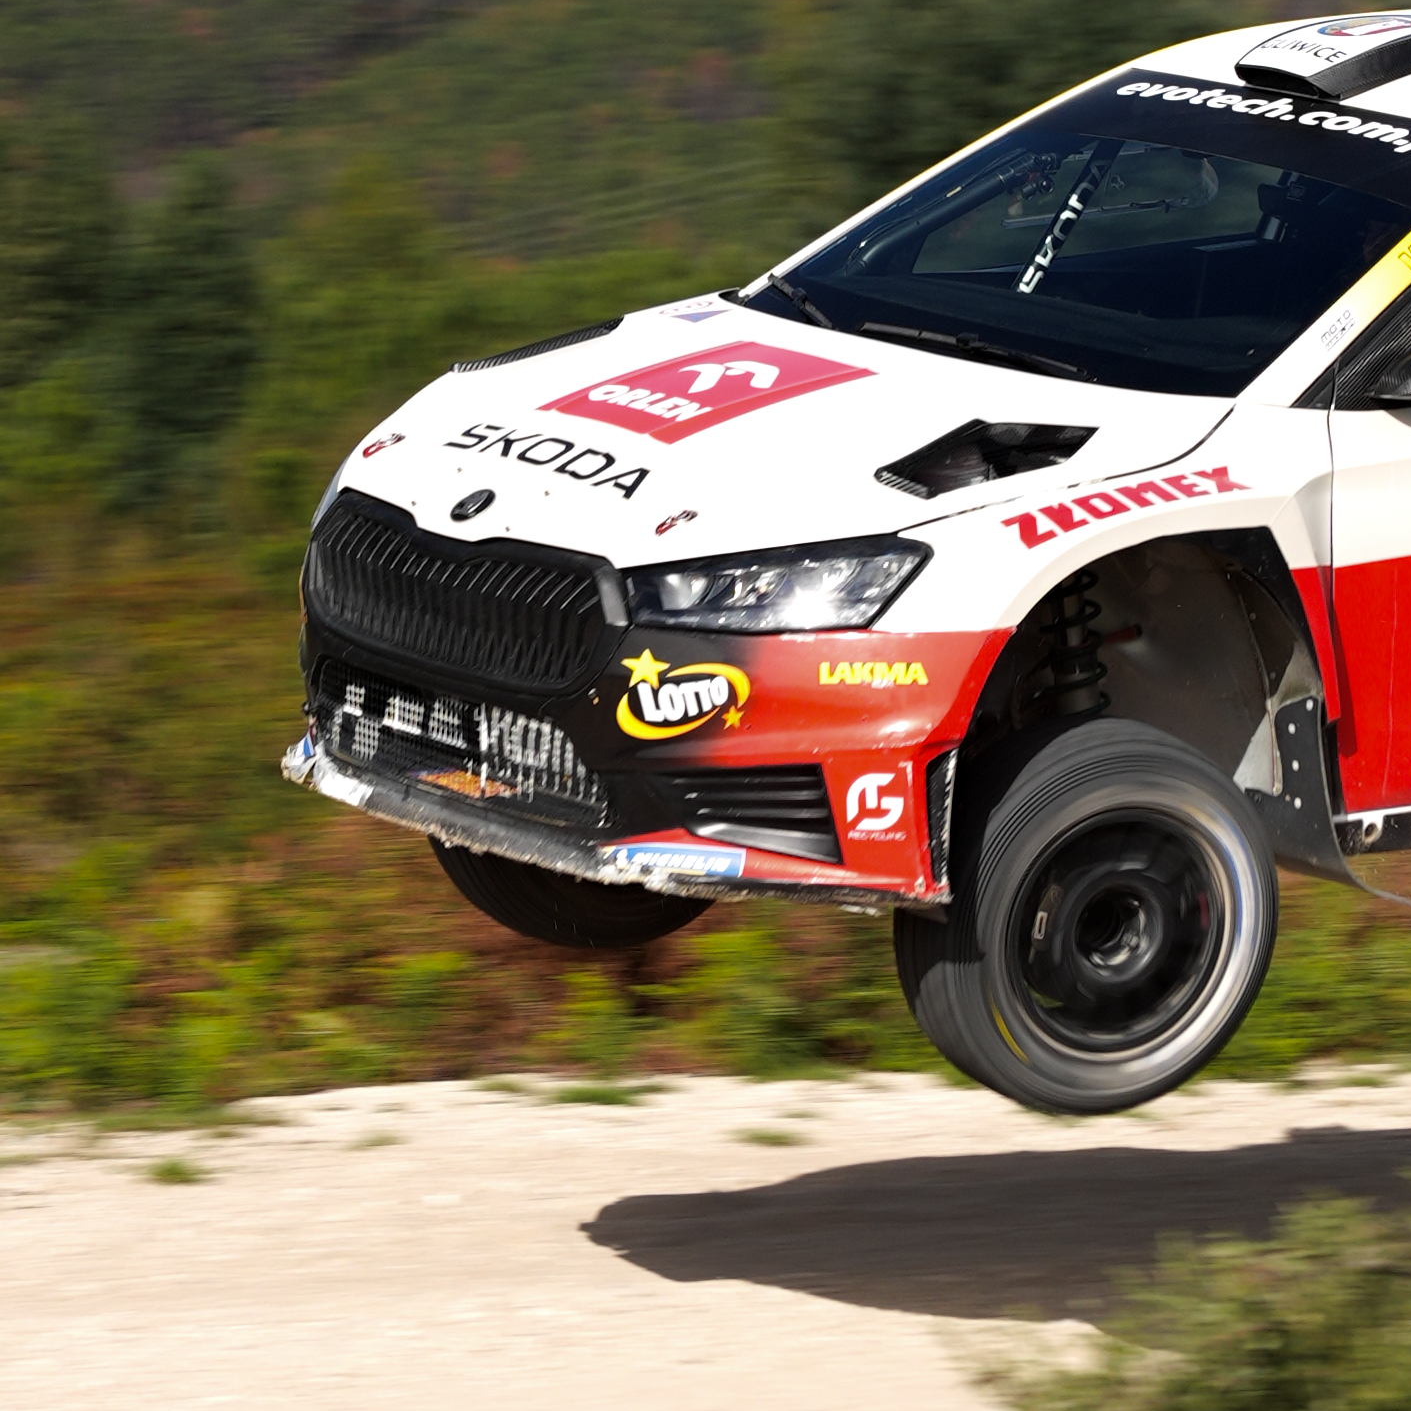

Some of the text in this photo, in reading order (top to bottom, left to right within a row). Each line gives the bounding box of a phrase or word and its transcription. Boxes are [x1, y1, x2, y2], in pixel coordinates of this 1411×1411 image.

[588, 384, 714, 422] ORLEN
[1000, 465, 1254, 549] ZŁOMEX
[819, 661, 929, 686] LAKMA
[631, 851, 731, 873] MICHELIN
